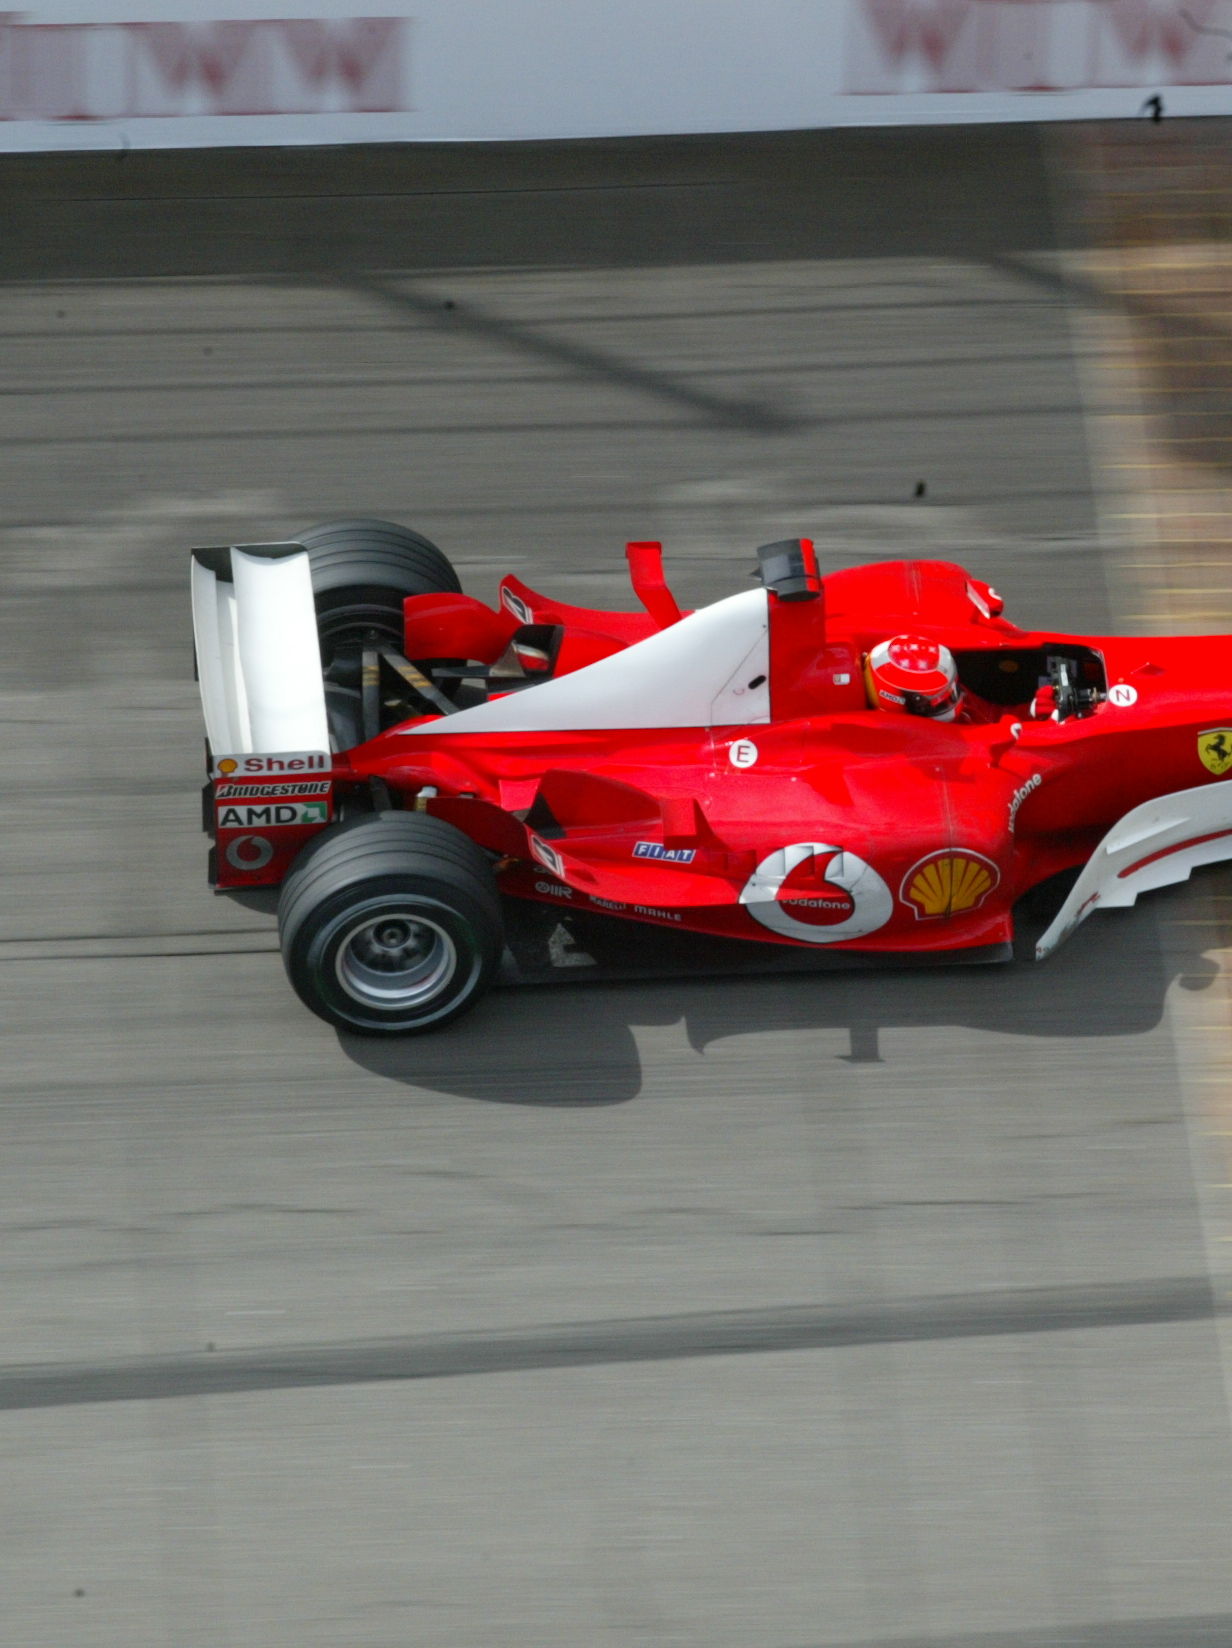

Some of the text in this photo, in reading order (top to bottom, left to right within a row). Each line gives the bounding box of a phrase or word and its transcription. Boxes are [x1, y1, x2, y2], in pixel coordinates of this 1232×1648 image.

[1115, 688, 1131, 702] N
[736, 745, 751, 763] E
[244, 755, 325, 772] Shell
[215, 780, 331, 798] BRIDGESTONE
[220, 805, 298, 827] AMD
[636, 844, 693, 861] FIAT
[634, 905, 682, 921] MAHLE
